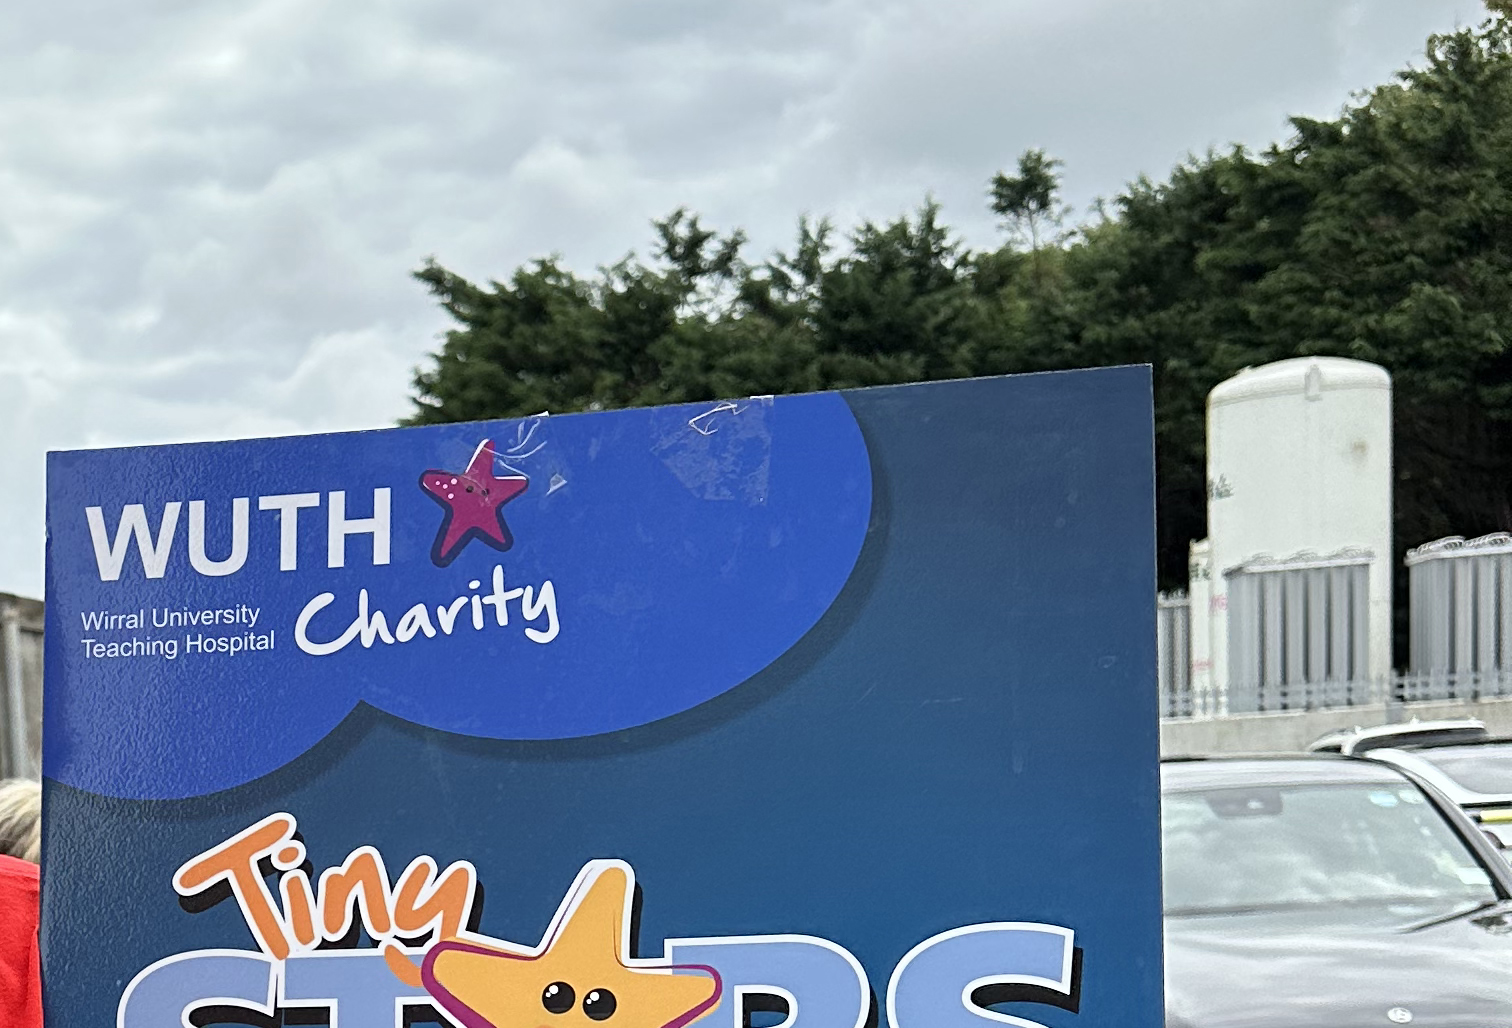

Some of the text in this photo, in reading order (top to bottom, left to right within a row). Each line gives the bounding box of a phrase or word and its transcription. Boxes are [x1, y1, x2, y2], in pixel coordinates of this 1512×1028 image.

[85, 487, 391, 582] WUTH
[80, 603, 261, 632] Wirral University
[80, 629, 275, 660] Teaching Hospital
[294, 564, 560, 656] Charity
[173, 812, 478, 988] Tiny
